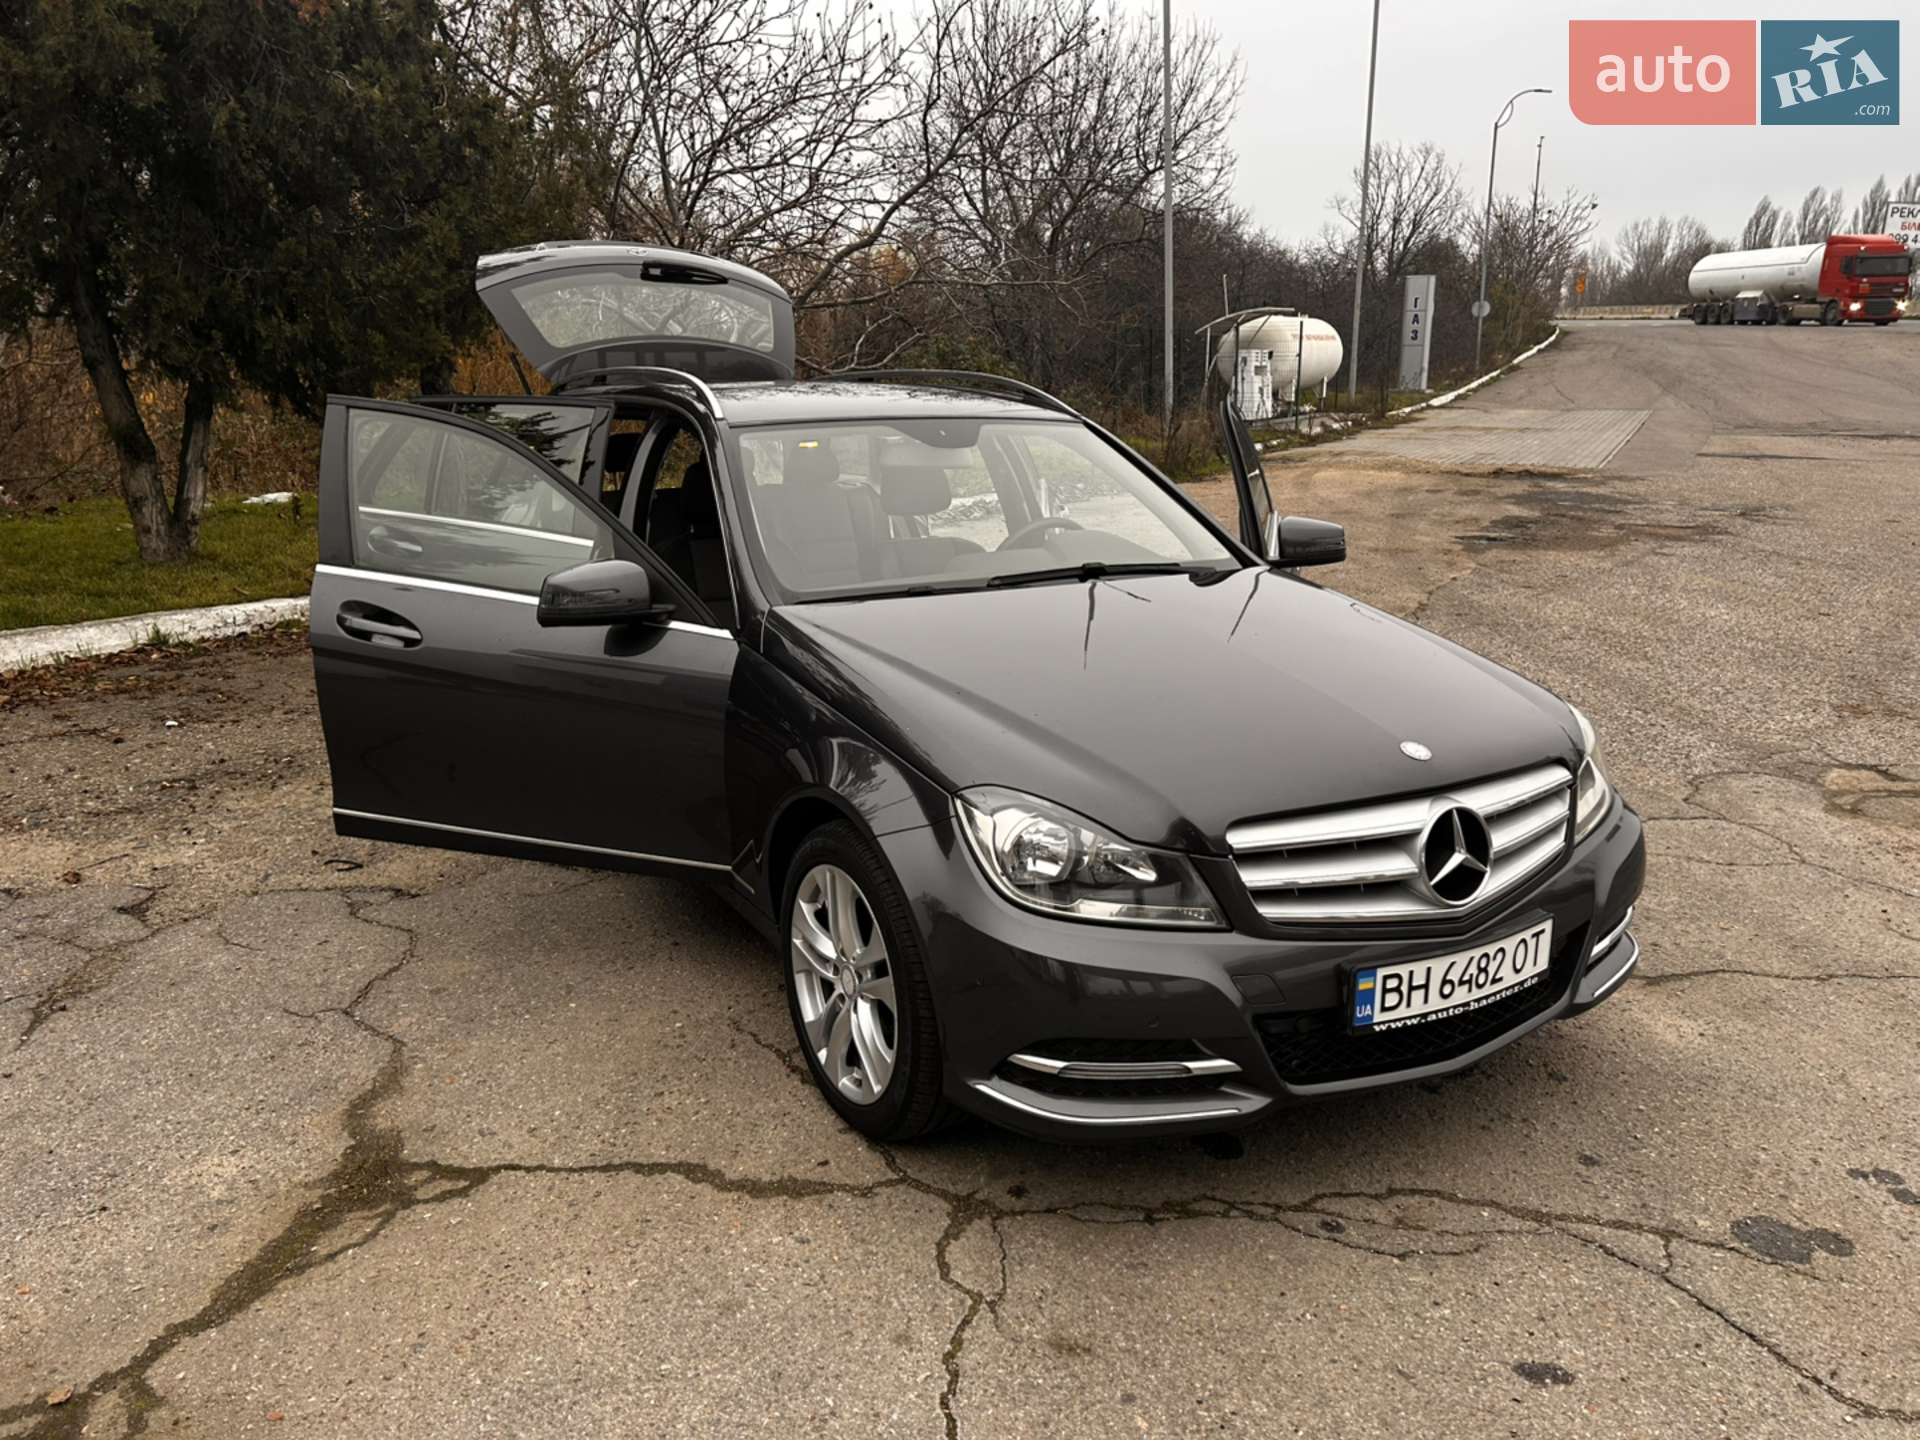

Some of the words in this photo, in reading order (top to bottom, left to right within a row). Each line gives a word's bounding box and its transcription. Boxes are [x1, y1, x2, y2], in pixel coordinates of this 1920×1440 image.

[1411, 296, 1421, 341] ГАЗ
[1379, 966, 1432, 1014] BH
[1439, 946, 1507, 1001] 6482
[1512, 928, 1546, 975] OT
[1356, 1005, 1373, 1018] UA
